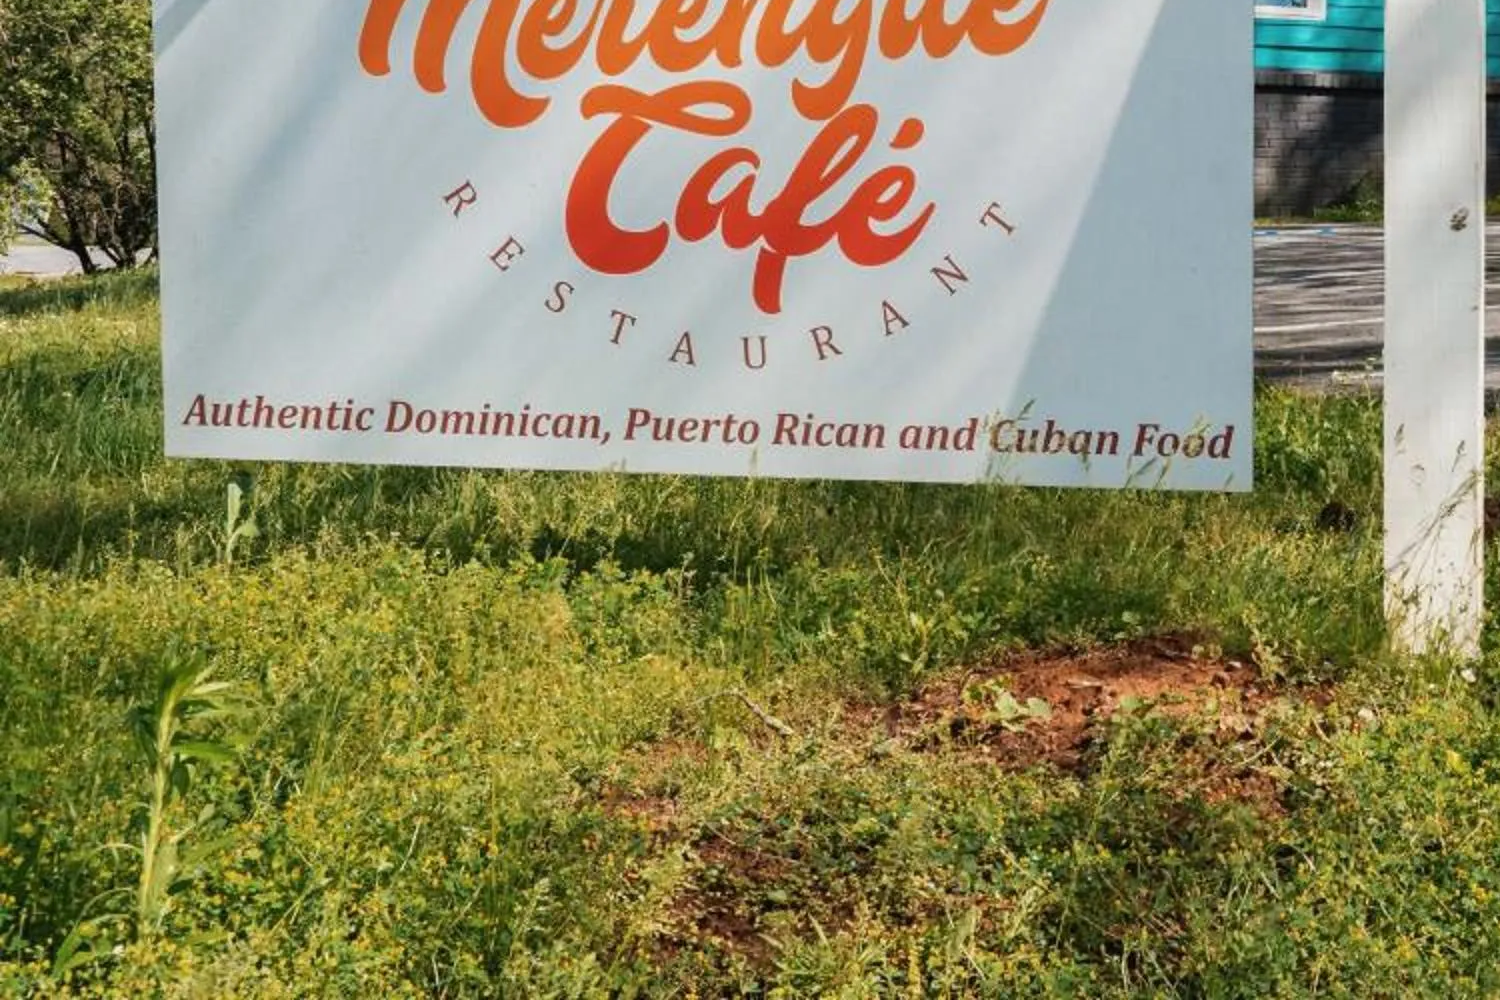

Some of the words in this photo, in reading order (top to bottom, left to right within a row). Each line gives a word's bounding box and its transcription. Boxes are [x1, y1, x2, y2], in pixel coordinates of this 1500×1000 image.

[443, 180, 1018, 371] RESTAURANT
[564, 80, 937, 315] Café
[183, 393, 374, 433] Authentic
[384, 400, 611, 445] Dominican,
[623, 408, 760, 446] Puerto
[770, 413, 886, 449] Rican
[898, 417, 977, 452] and
[990, 419, 1119, 458] Cuban
[1132, 423, 1235, 460] Food
